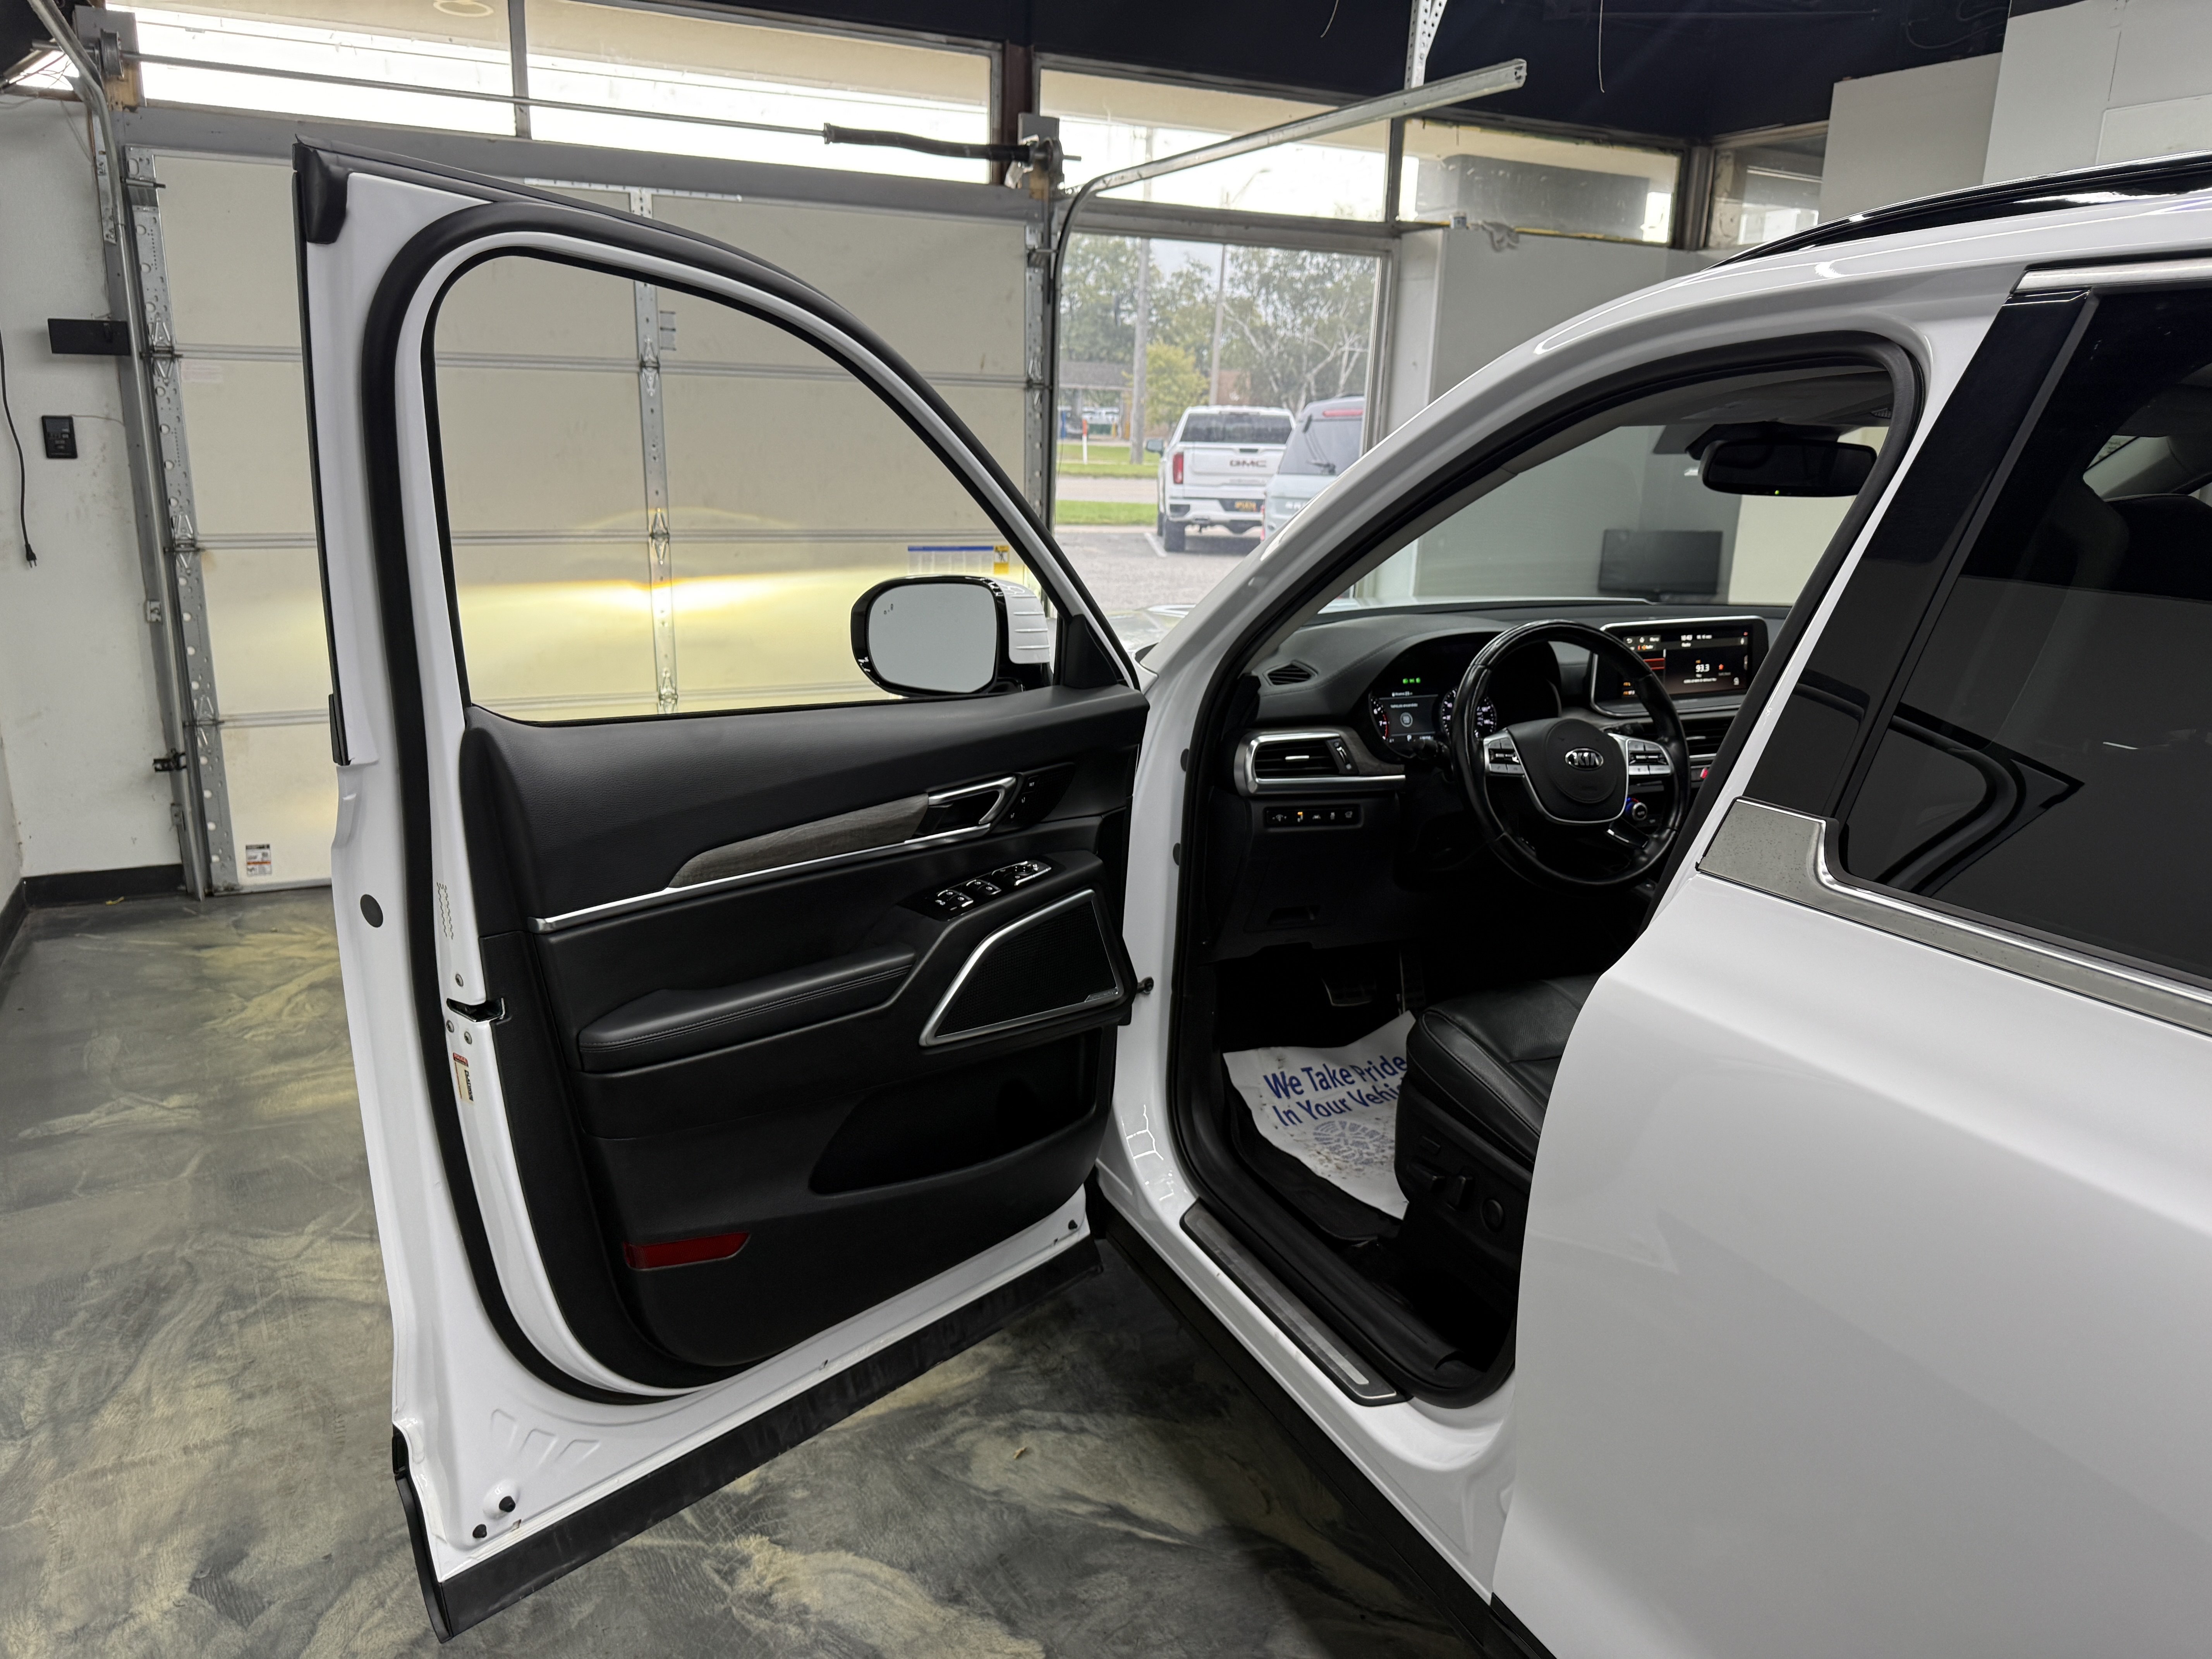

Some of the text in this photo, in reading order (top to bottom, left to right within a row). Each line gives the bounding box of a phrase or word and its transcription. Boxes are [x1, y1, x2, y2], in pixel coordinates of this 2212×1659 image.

[1230, 459, 1267, 467] GMC
[1695, 664, 1710, 672] 93.3
[1572, 752, 1599, 766] KIA
[1263, 1055, 1407, 1099] We Take Pride
[1274, 1077, 1403, 1127] In Your Vehi
